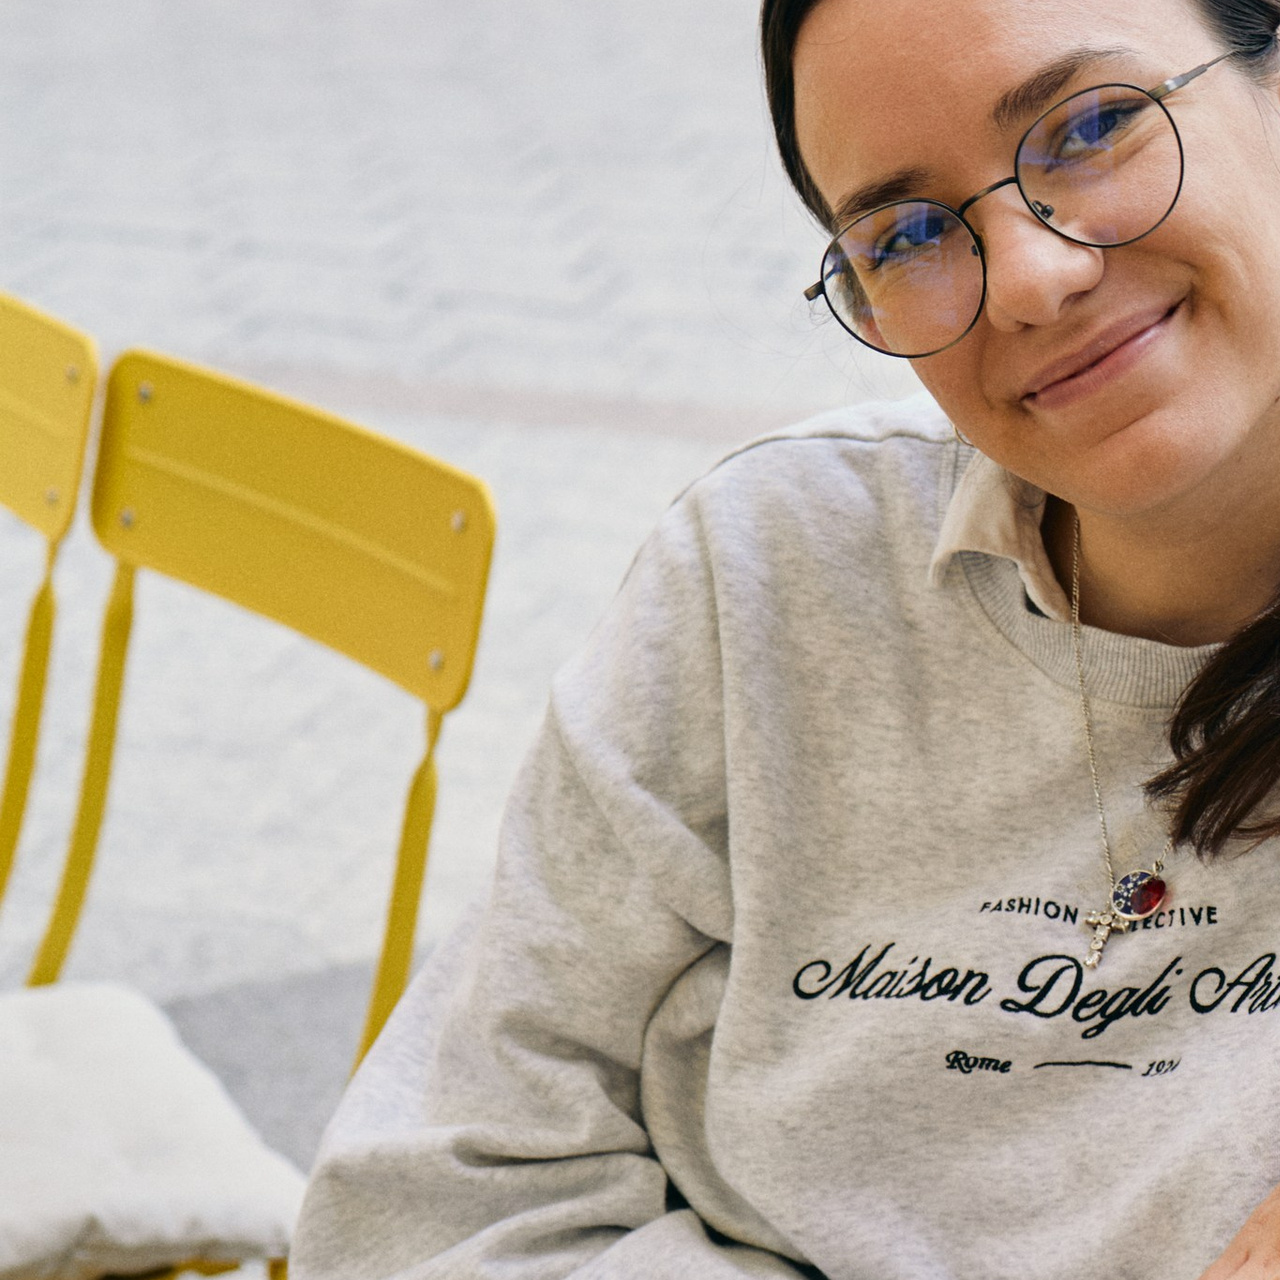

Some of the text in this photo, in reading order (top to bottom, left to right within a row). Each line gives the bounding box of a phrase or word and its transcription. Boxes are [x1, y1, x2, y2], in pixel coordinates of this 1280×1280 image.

[979, 896, 1080, 925] FASHION
[792, 942, 993, 1006] Maison
[999, 954, 1183, 1040] Degli
[945, 1049, 1013, 1076] Rome
